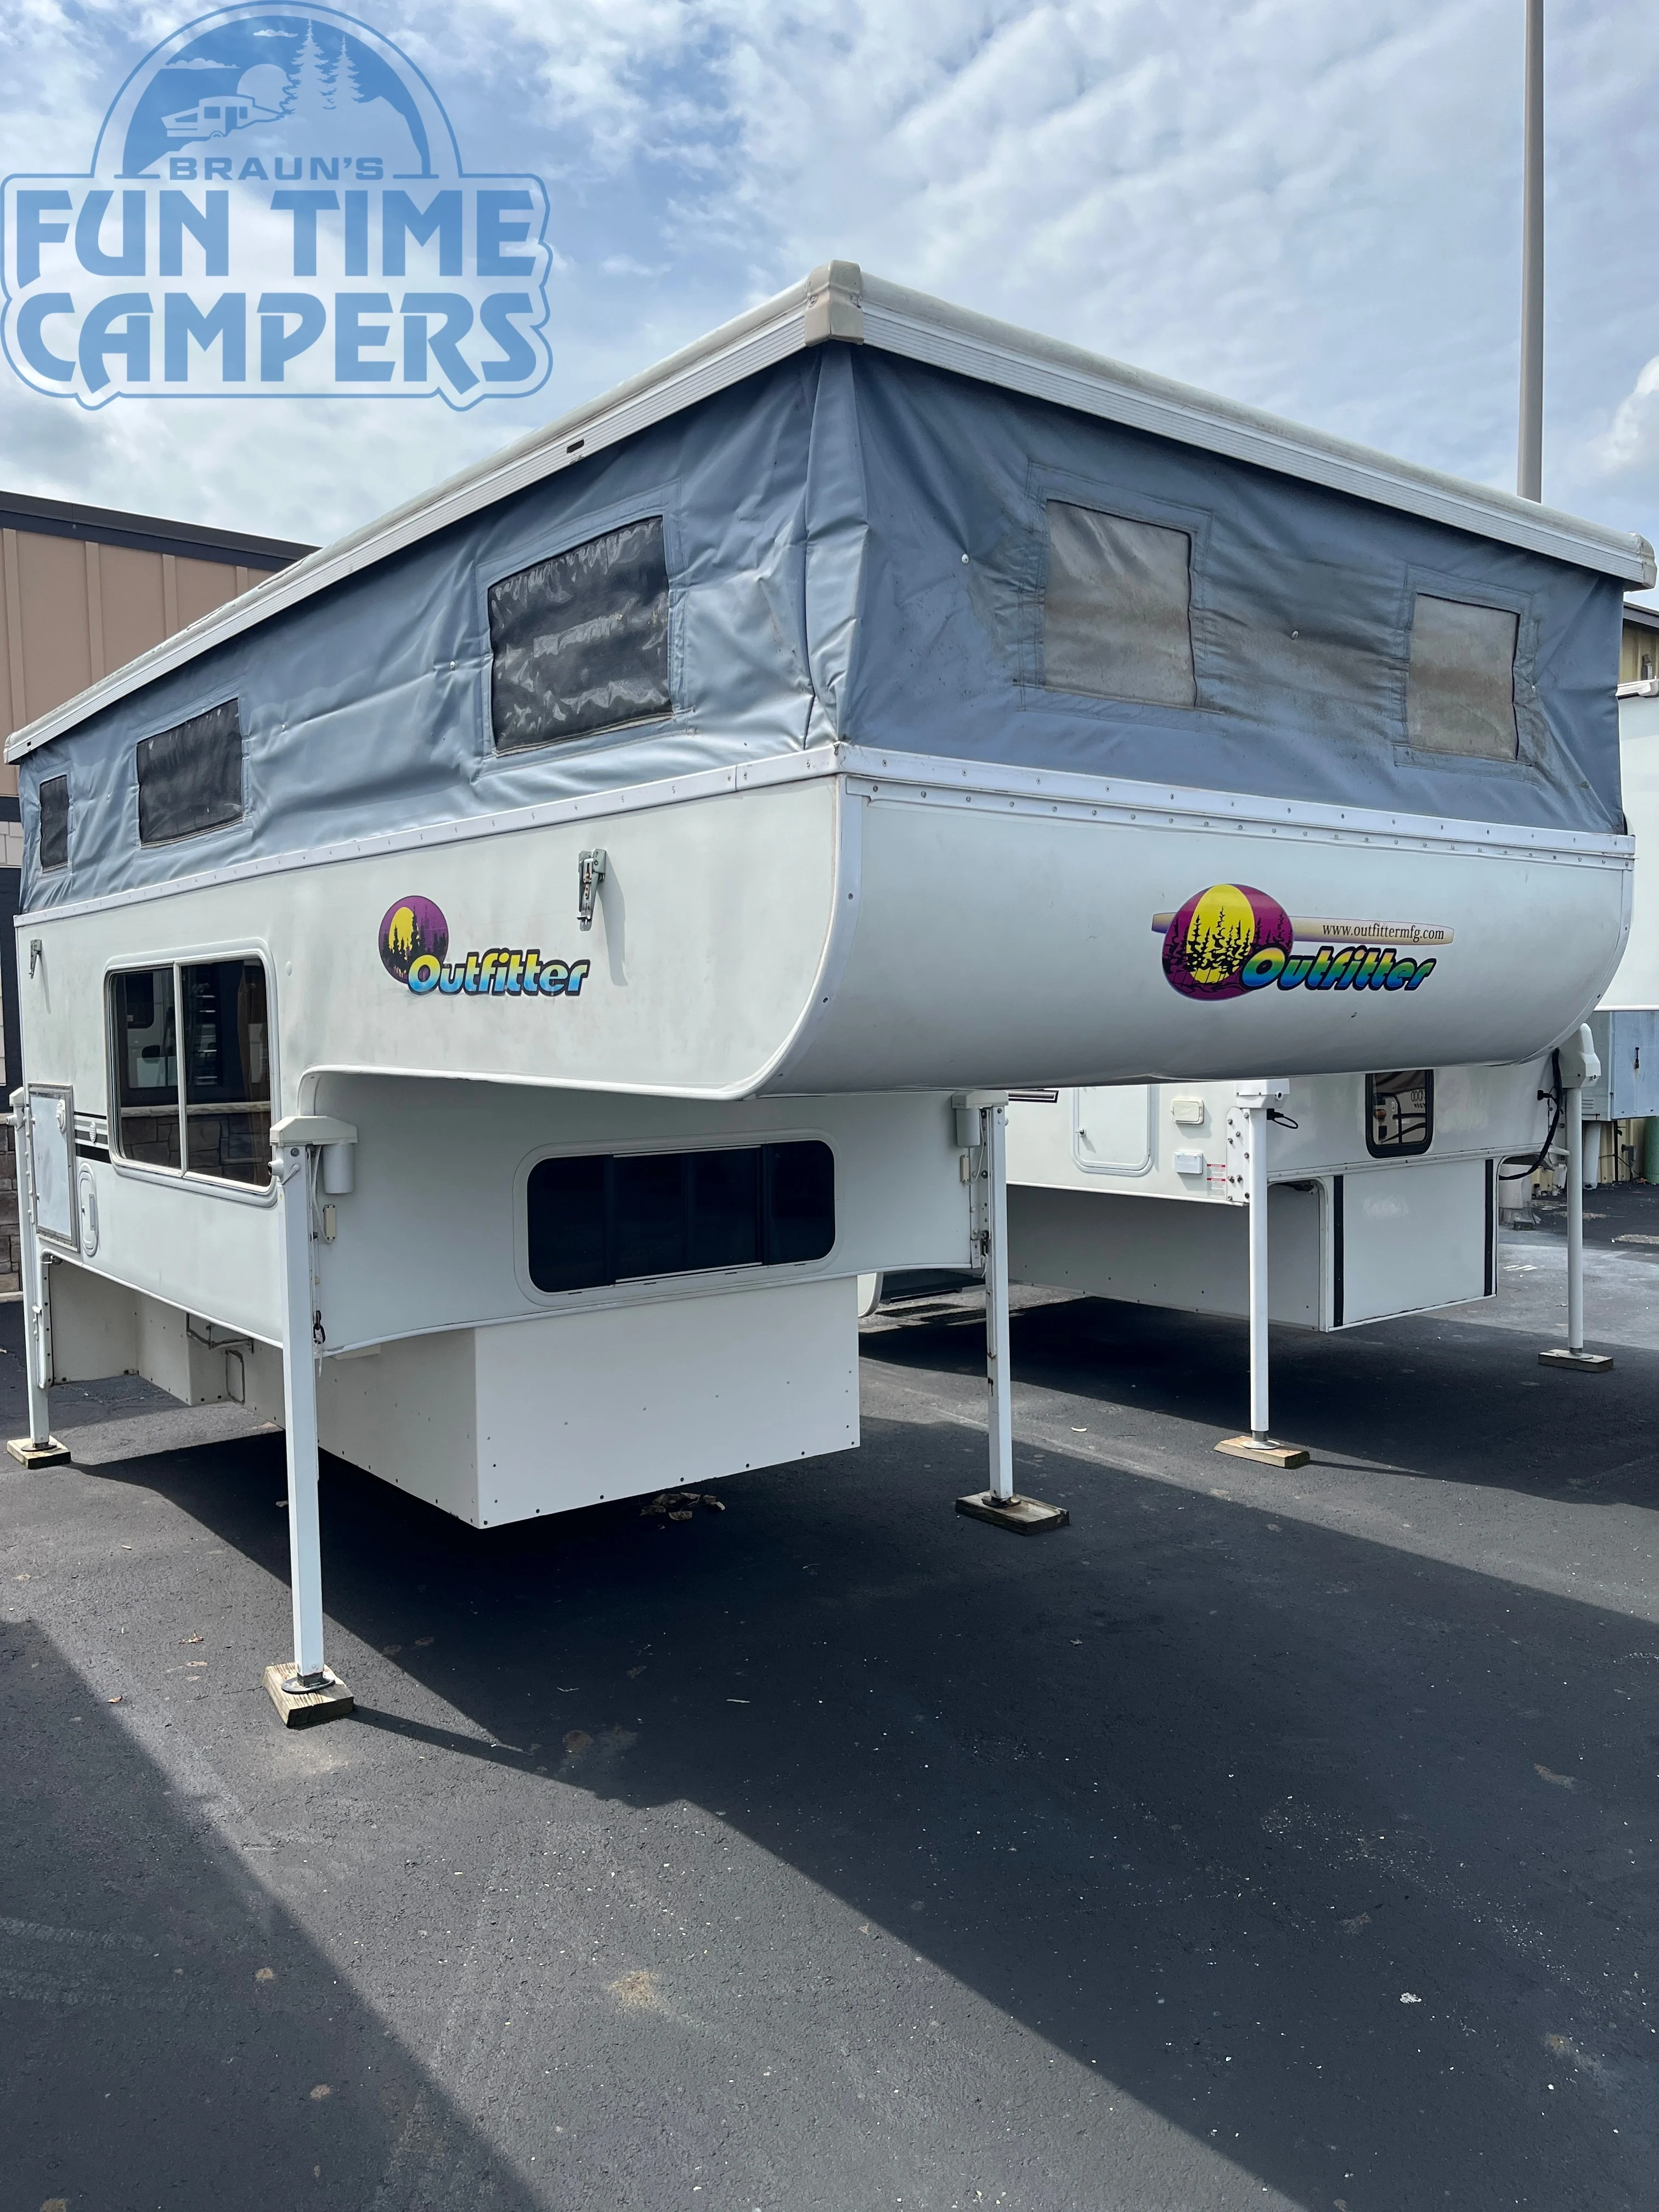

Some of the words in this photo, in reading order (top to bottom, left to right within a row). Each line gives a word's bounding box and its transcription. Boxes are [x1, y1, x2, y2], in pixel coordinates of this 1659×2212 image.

[1322, 924, 1444, 942] www.outfittermfg.com
[408, 948, 590, 996] Outfitter
[1240, 945, 1436, 991] Outfitter
